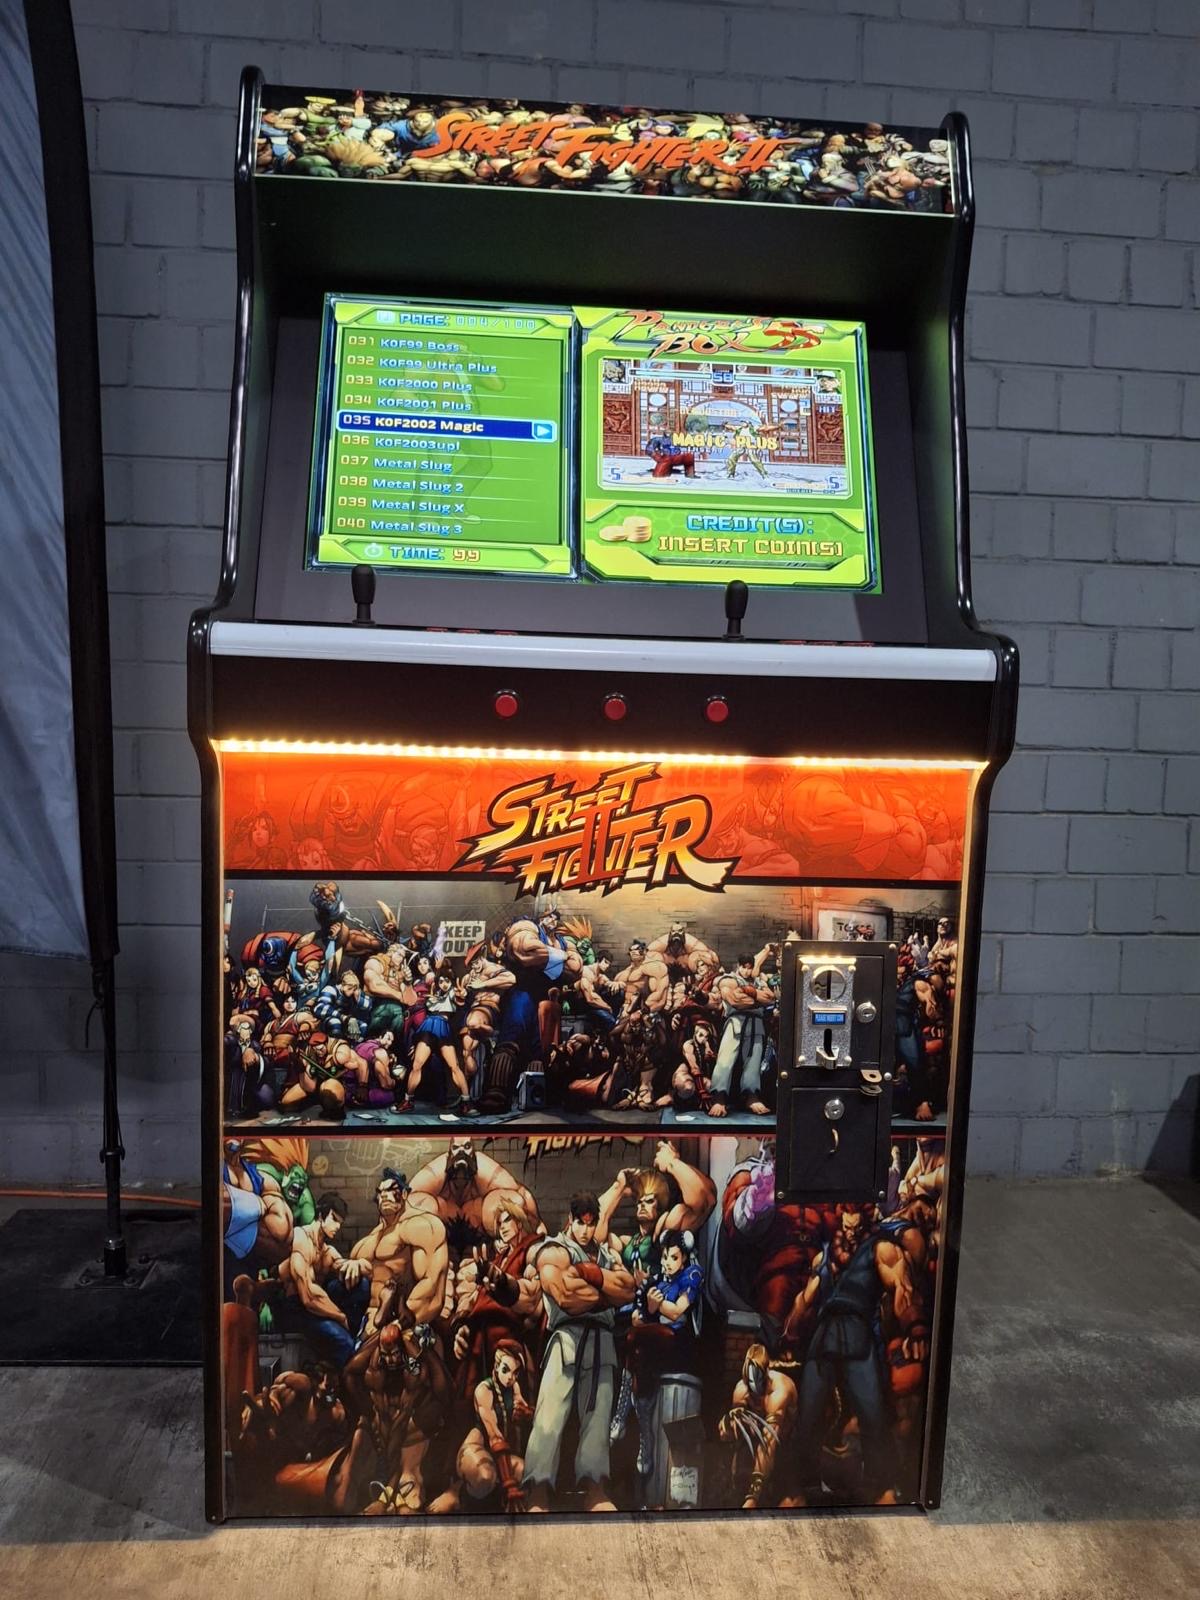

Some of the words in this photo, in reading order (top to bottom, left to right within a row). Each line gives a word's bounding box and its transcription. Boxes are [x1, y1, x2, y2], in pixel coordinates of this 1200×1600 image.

[414, 113, 570, 159] STREET
[549, 127, 740, 175] FIGHTER
[400, 313, 449, 326] PAGE:
[348, 335, 375, 346] 031
[427, 341, 460, 352] Boss
[648, 332, 764, 360] BOX
[347, 355, 374, 366] 032
[426, 361, 463, 372] Ultra
[468, 363, 497, 373] Plus
[345, 374, 373, 385] 033
[442, 381, 472, 391] Plus
[344, 394, 372, 405] 034
[442, 401, 472, 411] Plus
[343, 414, 371, 425] 035
[440, 420, 484, 433] Magic
[342, 434, 370, 445] 036
[736, 435, 778, 450] PLUS
[340, 455, 369, 465] 037
[374, 457, 417, 469] Metal
[420, 460, 453, 473] Slug
[339, 475, 368, 487] 038
[372, 478, 416, 490] Metal
[419, 480, 452, 494] Slug
[455, 482, 464, 493] 2
[338, 496, 367, 507] 039
[371, 499, 415, 511] Metal
[418, 501, 451, 515] Slug
[454, 503, 465, 513] X
[337, 517, 366, 529] 040
[370, 520, 415, 533] Metal
[417, 523, 450, 536] Slug
[453, 524, 463, 534] 3
[390, 545, 445, 560] TIME:
[453, 548, 480, 561] 99
[659, 536, 748, 553] INSERT
[464, 762, 661, 862] STREET
[444, 925, 482, 938] KEEP
[443, 940, 476, 954] OUT
